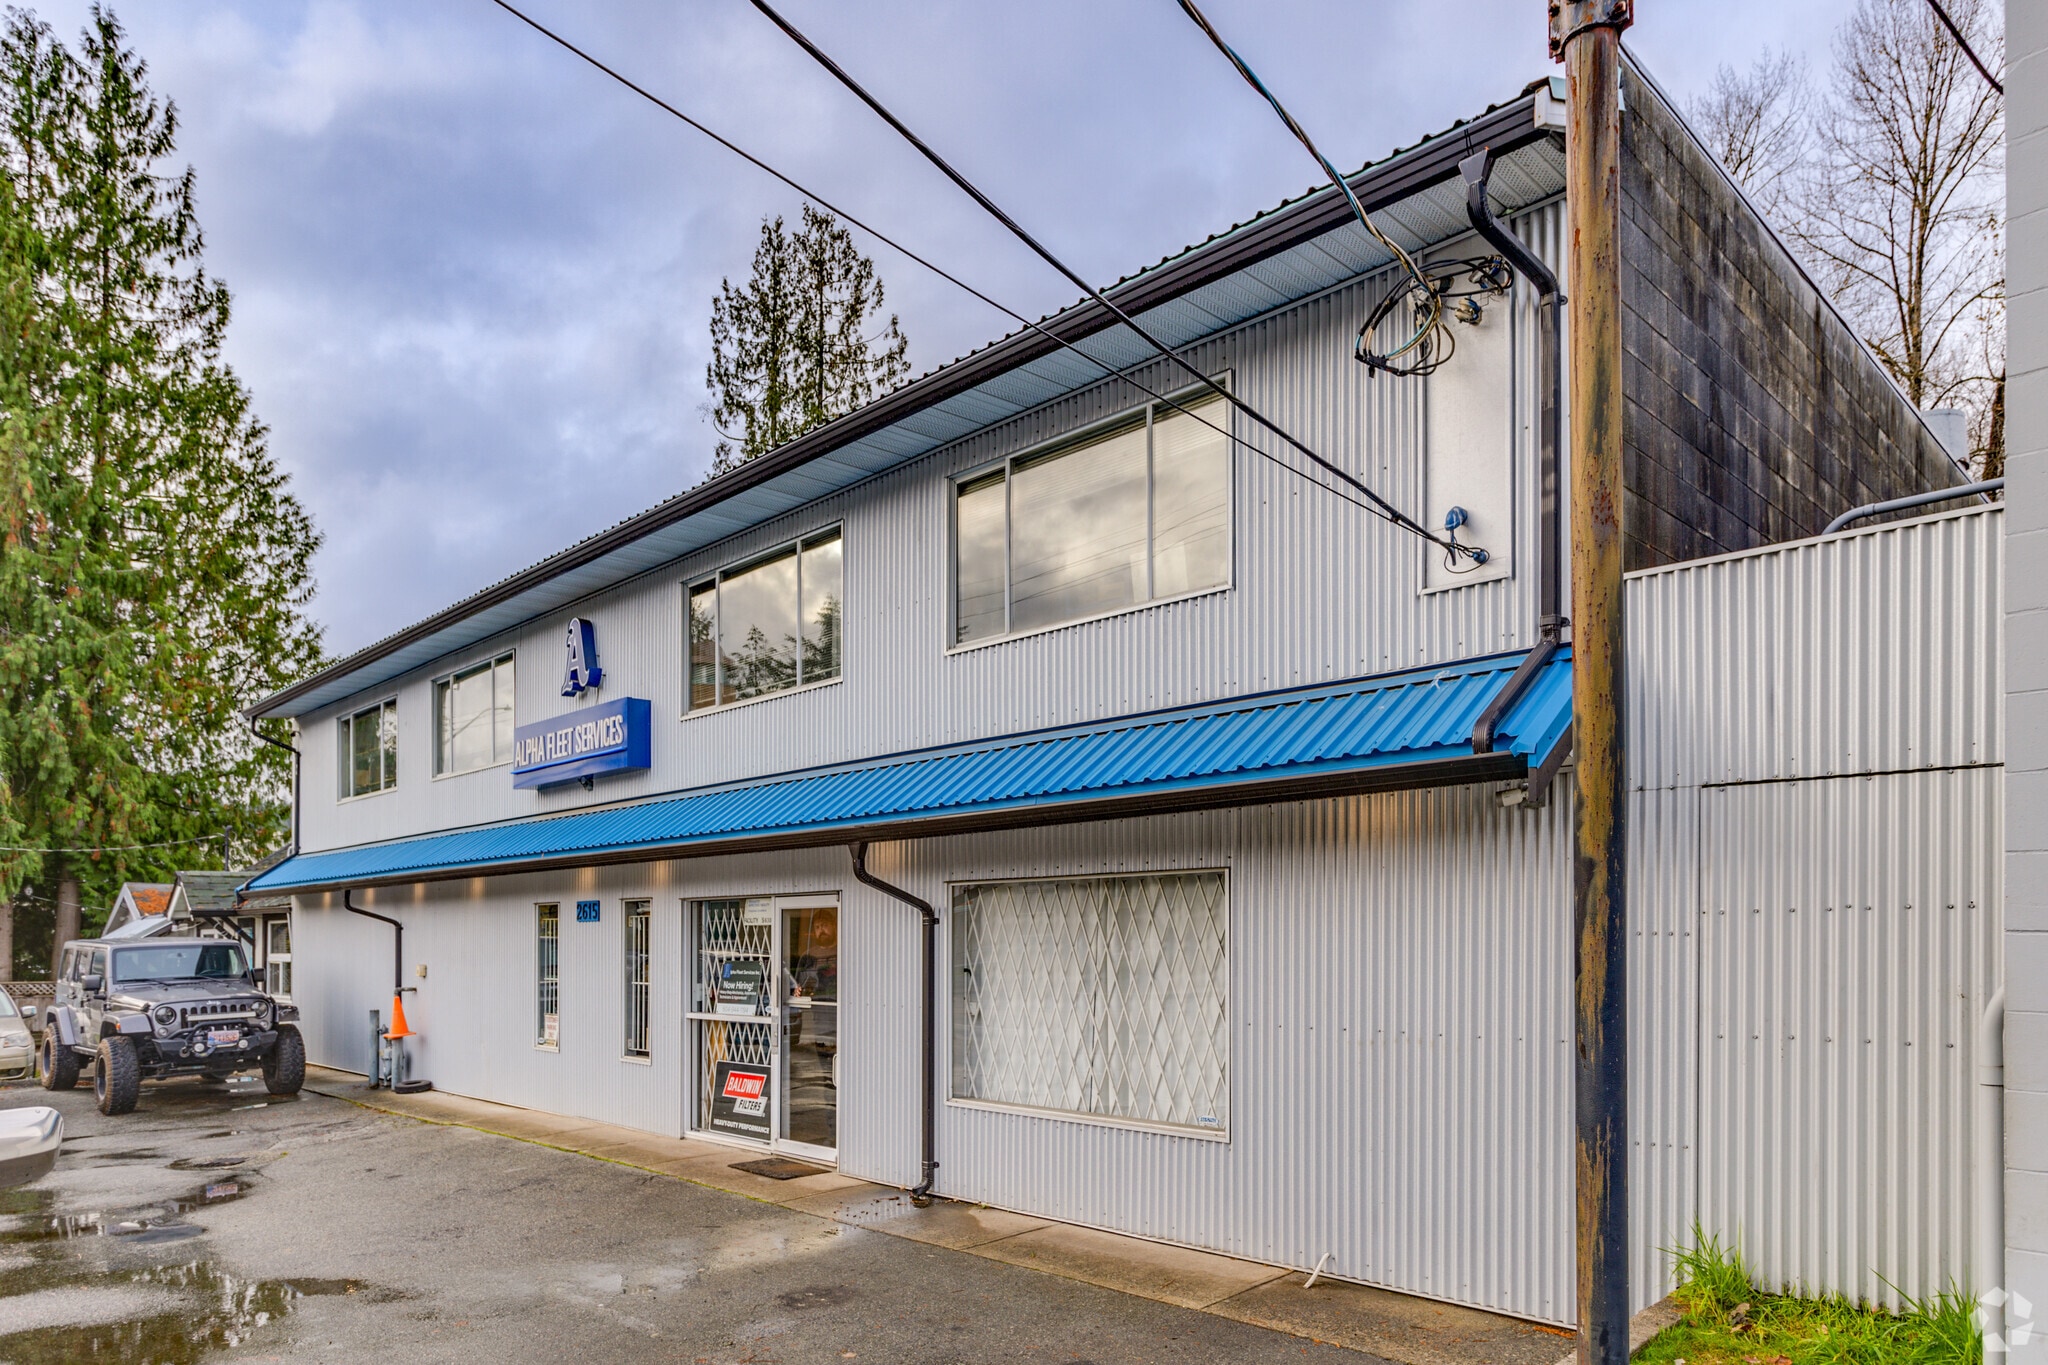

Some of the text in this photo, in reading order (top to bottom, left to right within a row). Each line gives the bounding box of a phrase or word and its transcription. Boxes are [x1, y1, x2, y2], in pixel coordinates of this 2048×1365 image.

[514, 714, 624, 768] ALPHA FLEET SERVICES
[577, 903, 598, 921] 2615
[723, 981, 754, 992] Now Hiring!
[727, 1077, 762, 1095] BALDWIN
[738, 1099, 762, 1112] FILTERS
